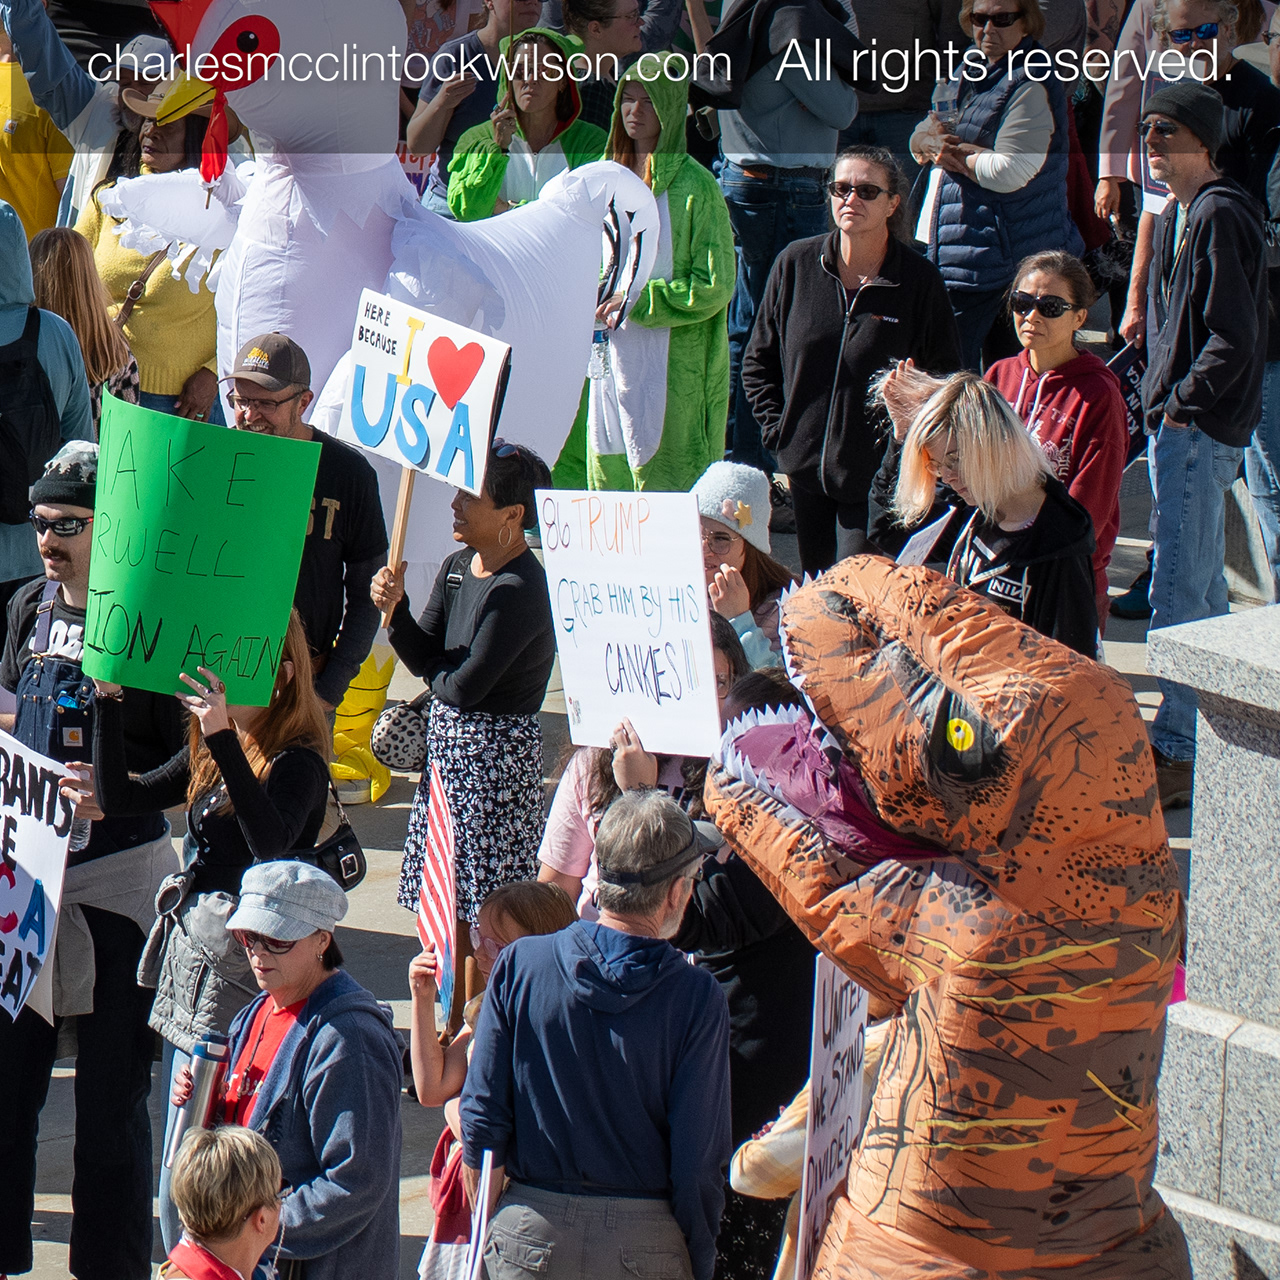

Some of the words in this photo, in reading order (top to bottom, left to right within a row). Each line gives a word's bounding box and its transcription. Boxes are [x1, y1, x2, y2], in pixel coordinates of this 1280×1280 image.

[358, 325, 397, 357] BECAUSE
[396, 316, 425, 387] I
[351, 364, 474, 490] USA
[542, 498, 571, 552] 86
[571, 496, 650, 556] TRUMP
[181, 624, 284, 681] AGAIN
